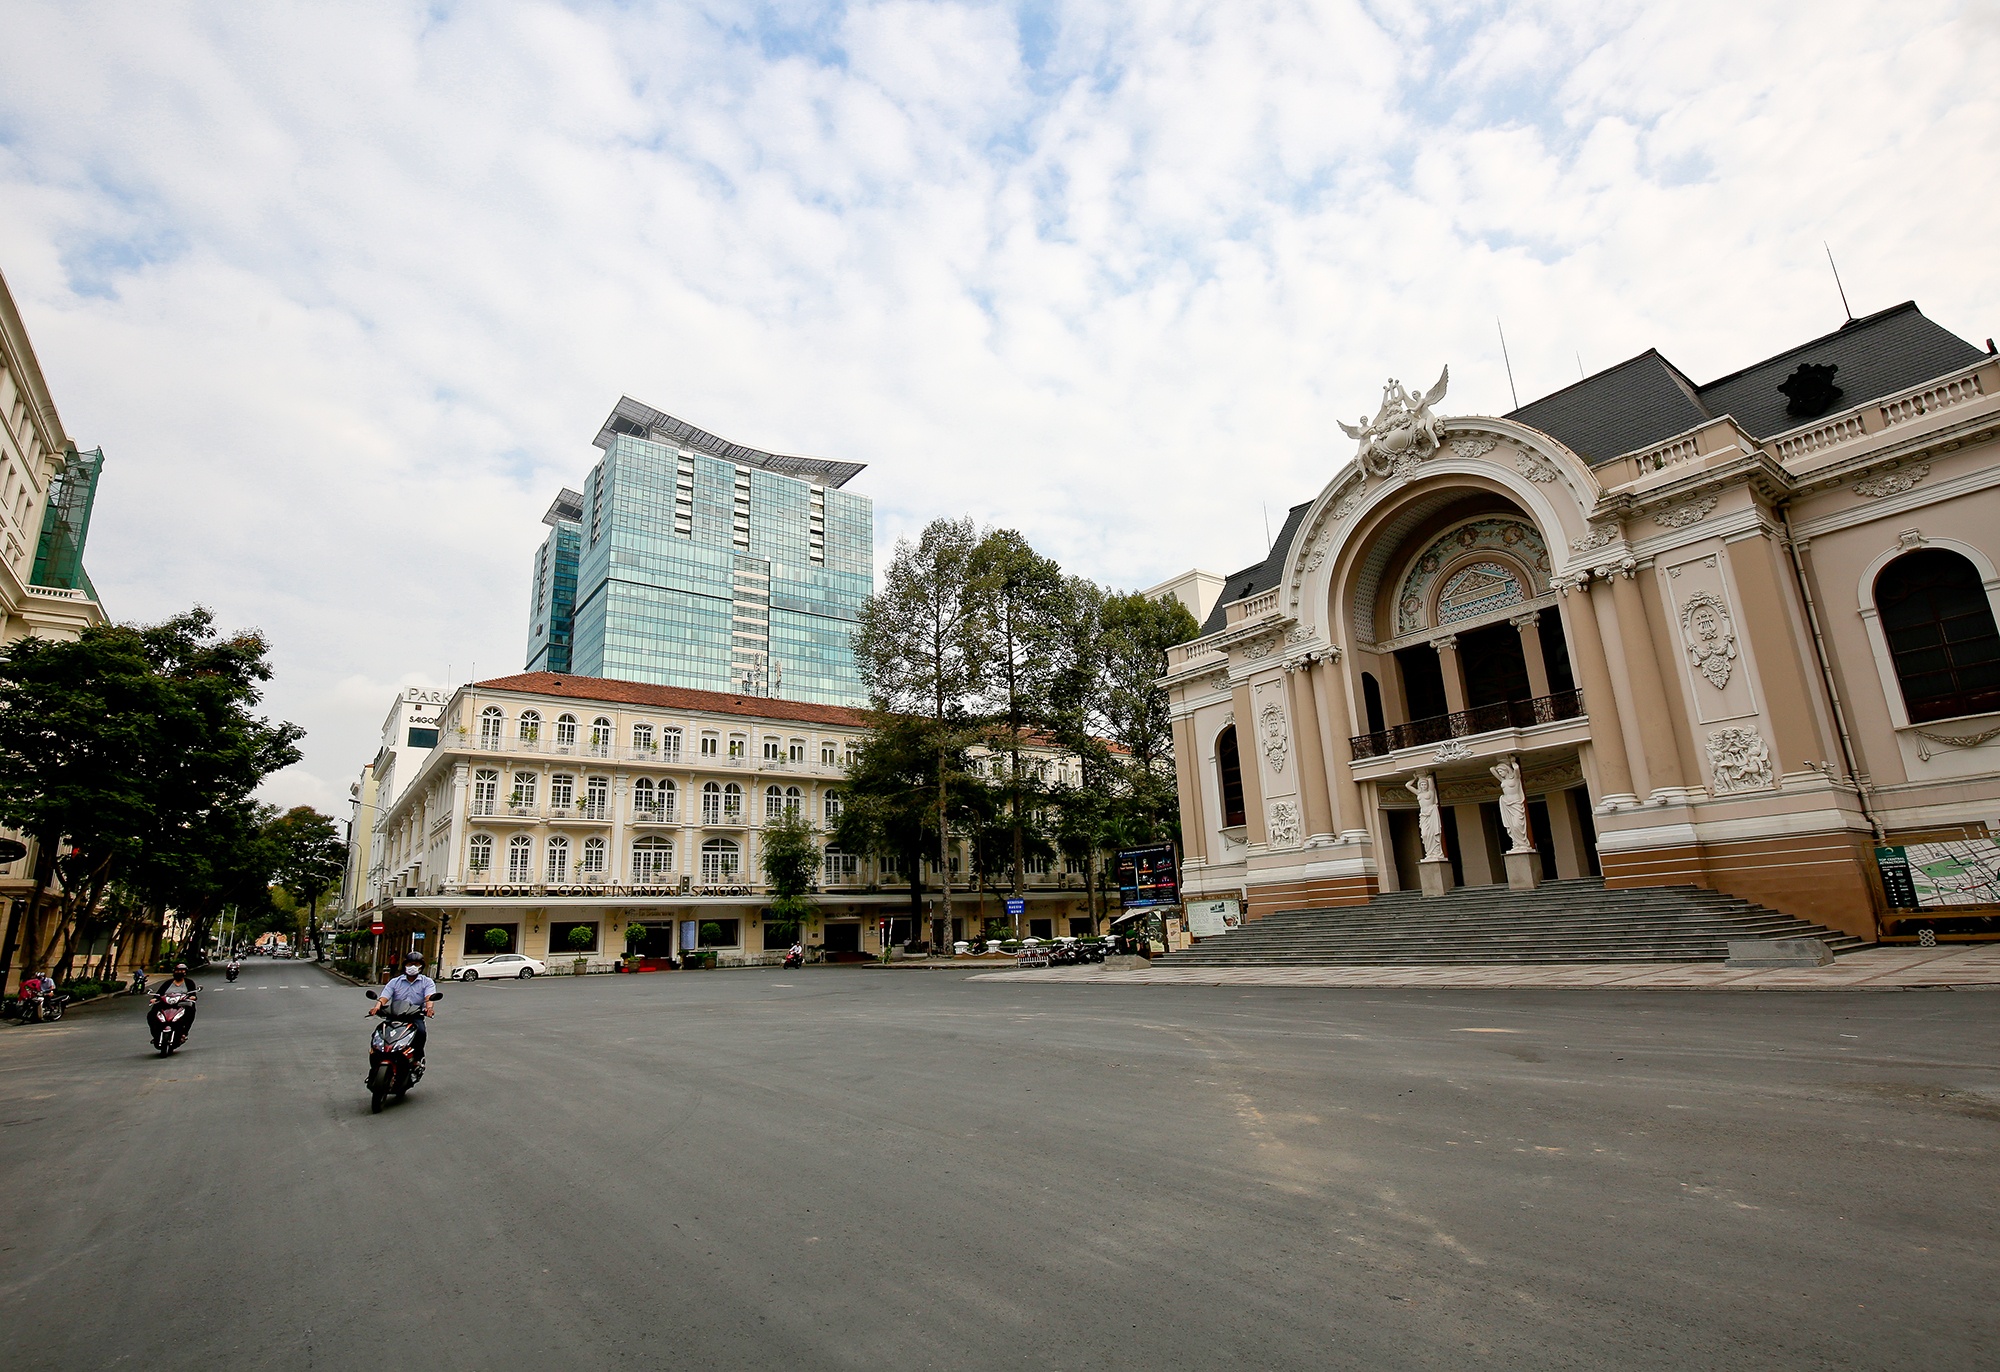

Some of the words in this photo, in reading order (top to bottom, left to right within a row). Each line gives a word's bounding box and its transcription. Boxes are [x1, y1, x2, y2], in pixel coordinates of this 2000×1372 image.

[408, 688, 453, 703] PARK
[484, 885, 548, 897] HOTEL
[691, 886, 754, 897] SAIGON
